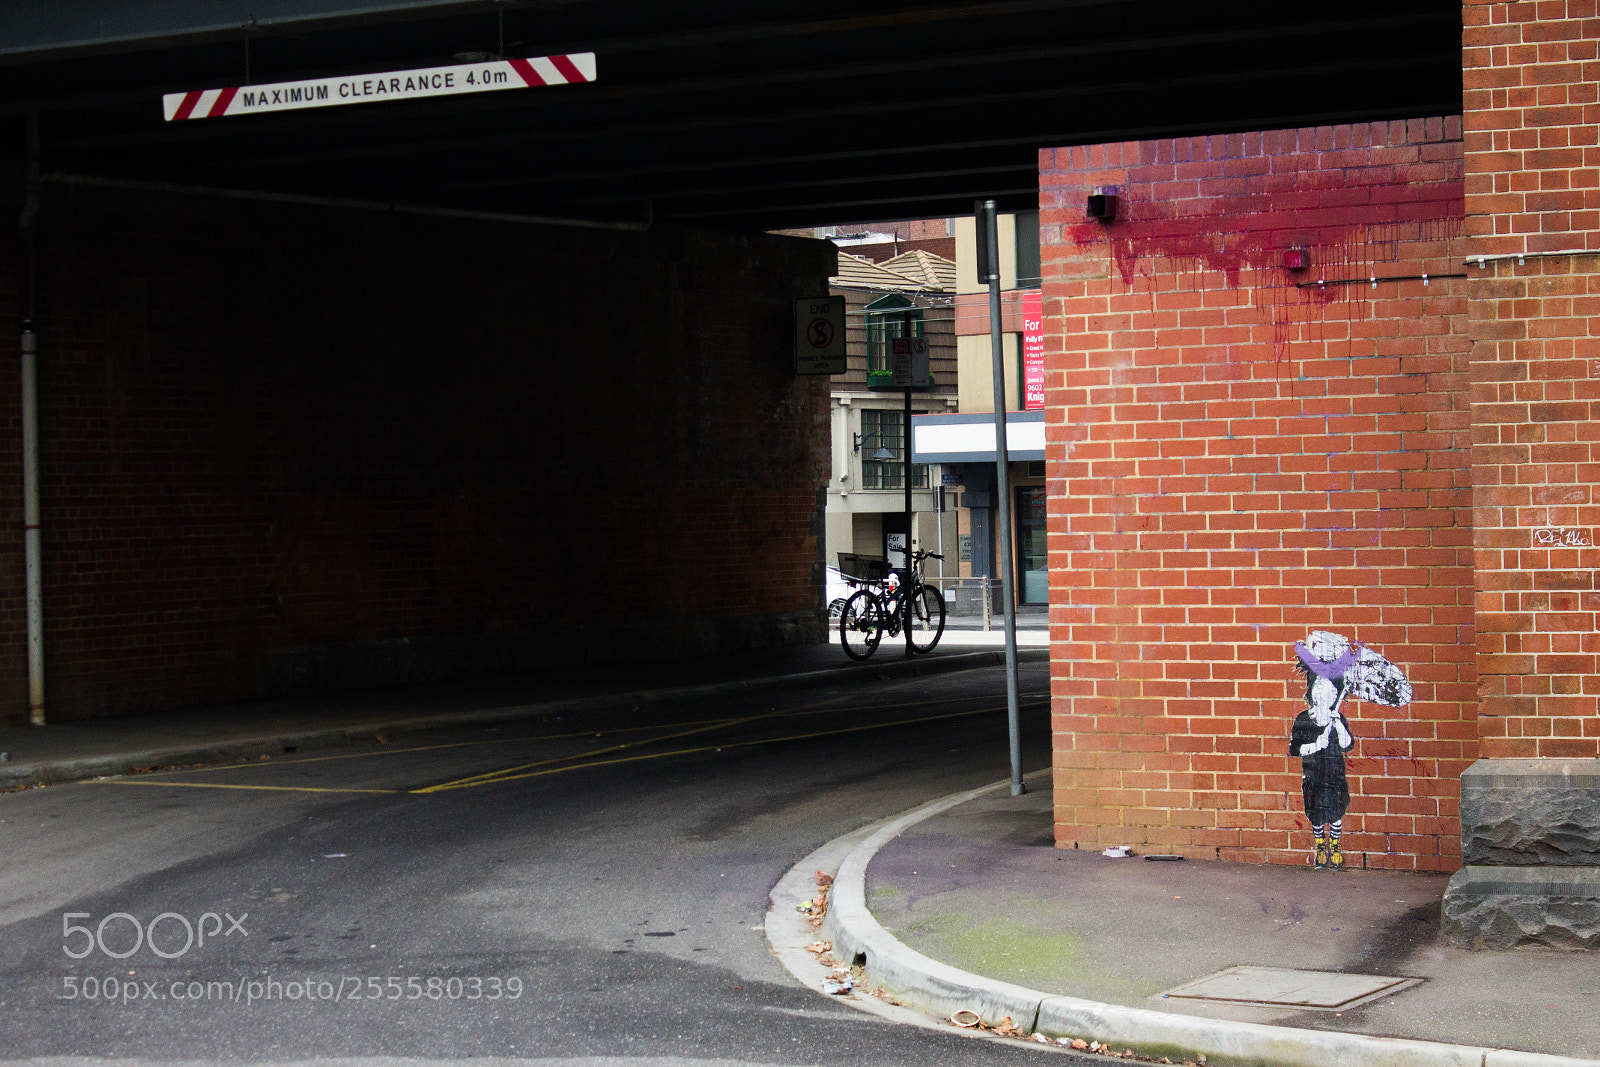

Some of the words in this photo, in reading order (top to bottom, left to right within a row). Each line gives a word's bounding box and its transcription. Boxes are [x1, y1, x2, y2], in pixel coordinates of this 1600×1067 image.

[243, 85, 329, 107] MAXIMUM
[339, 73, 456, 98] CLEARANCE
[466, 69, 509, 86] 4.0m
[810, 304, 830, 314] END
[1025, 319, 1040, 331] For
[1027, 384, 1043, 392] 9602
[1027, 391, 1044, 403] Knig
